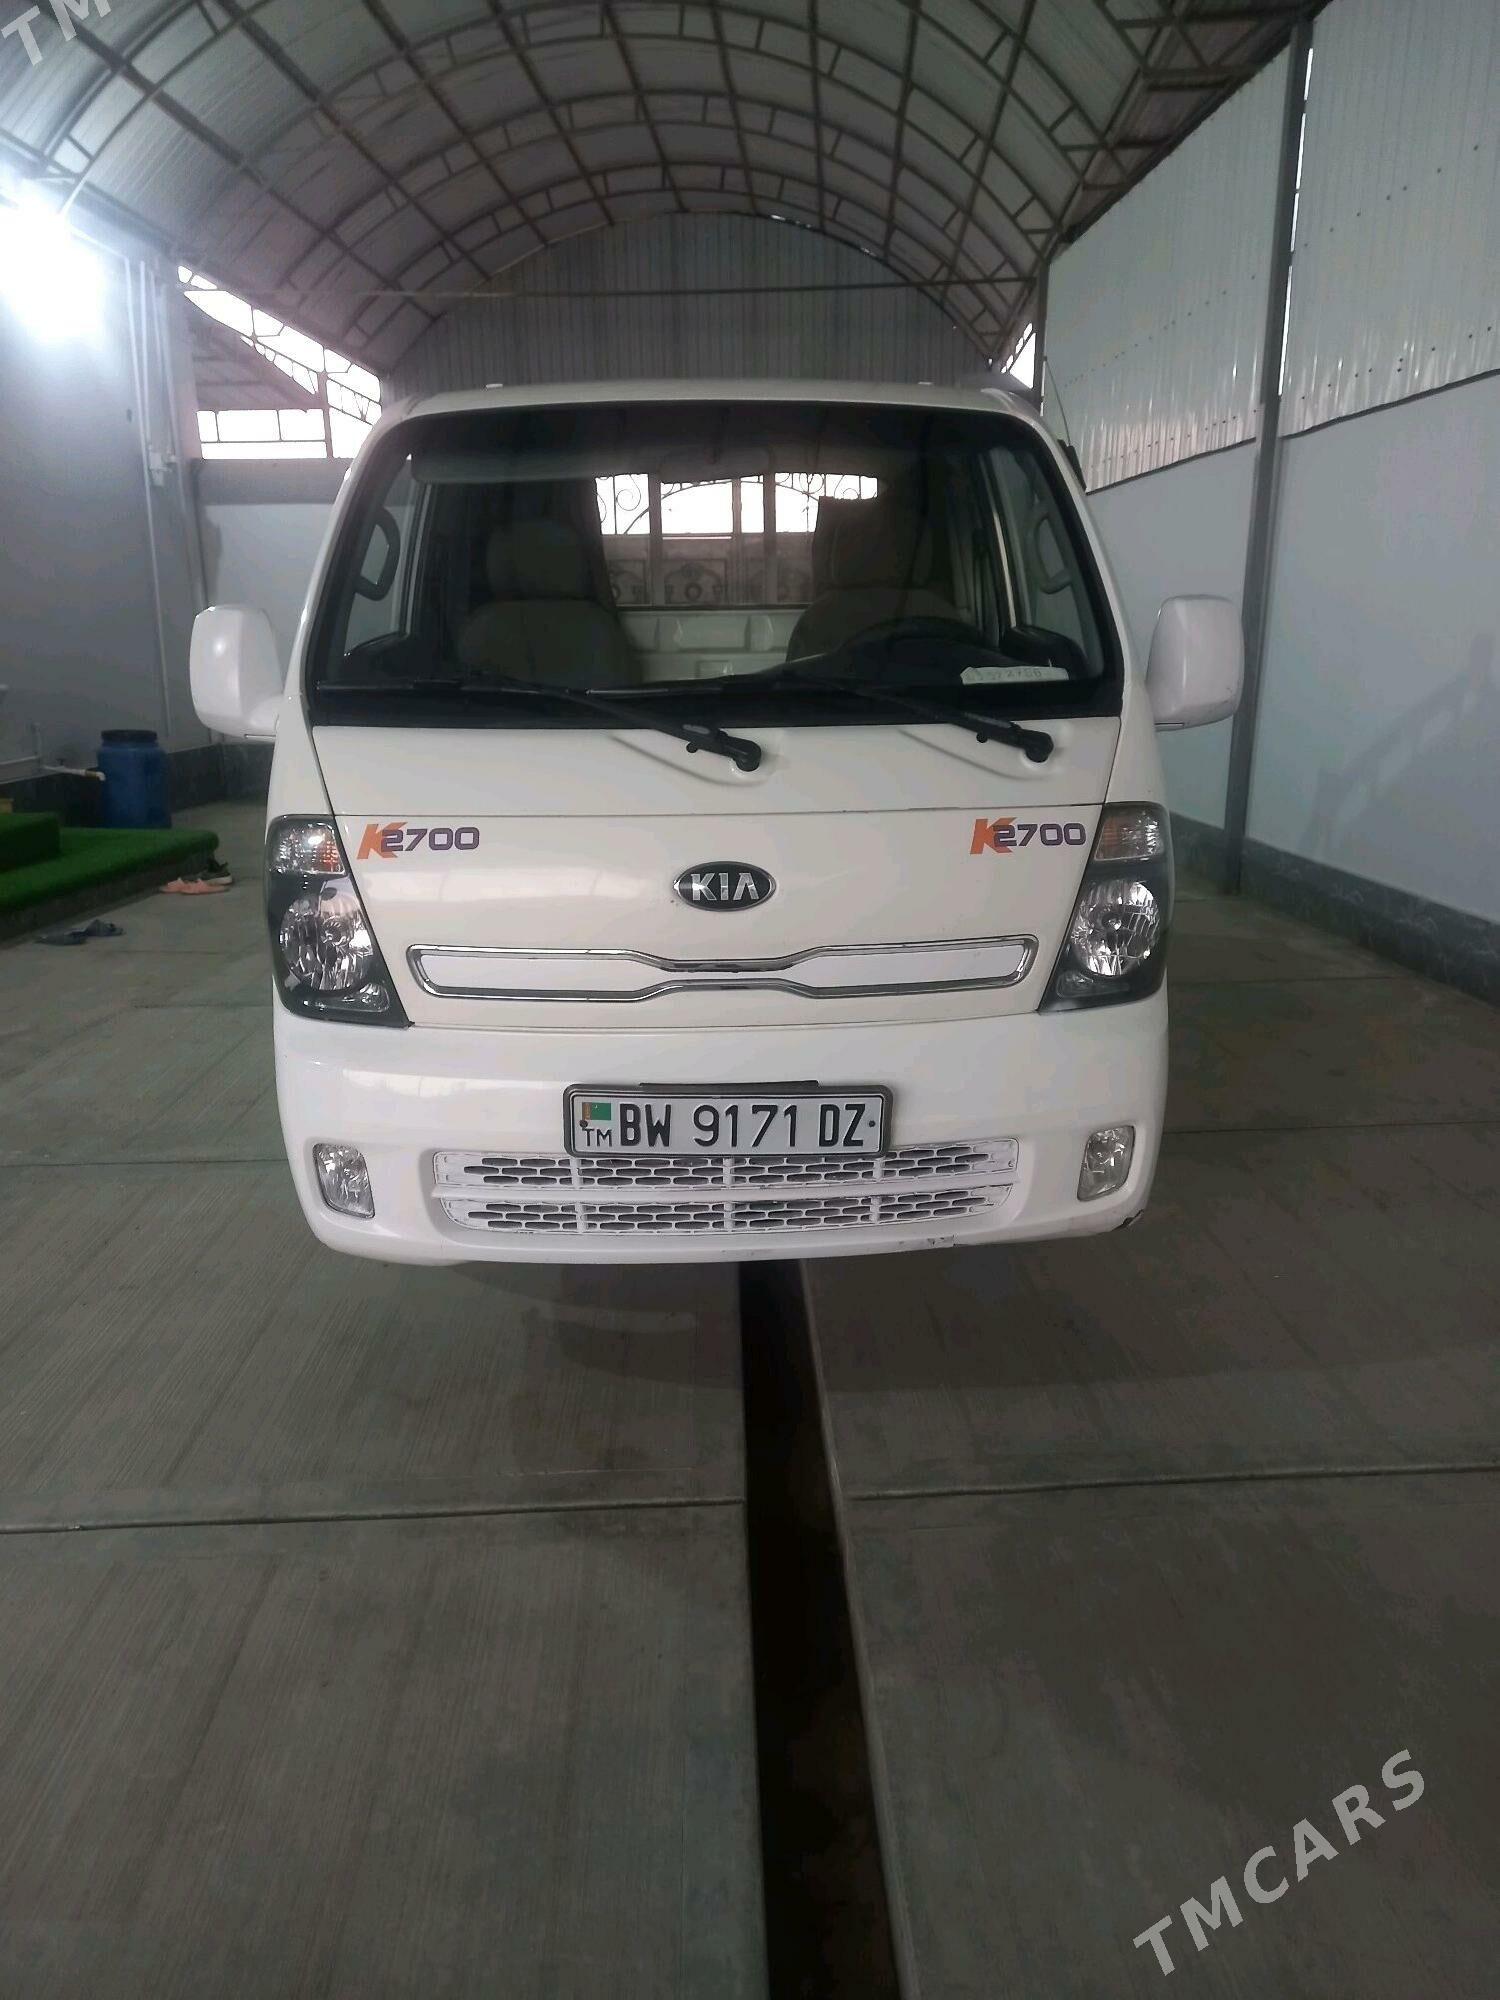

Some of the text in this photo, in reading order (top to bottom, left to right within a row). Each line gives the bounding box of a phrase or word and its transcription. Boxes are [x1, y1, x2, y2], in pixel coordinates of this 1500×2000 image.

[357, 821, 480, 860] K2700
[969, 816, 1087, 855] K2700
[691, 872, 761, 901] KIA
[583, 1128, 613, 1147] TM
[620, 1103, 866, 1147] BW 9171 DZ
